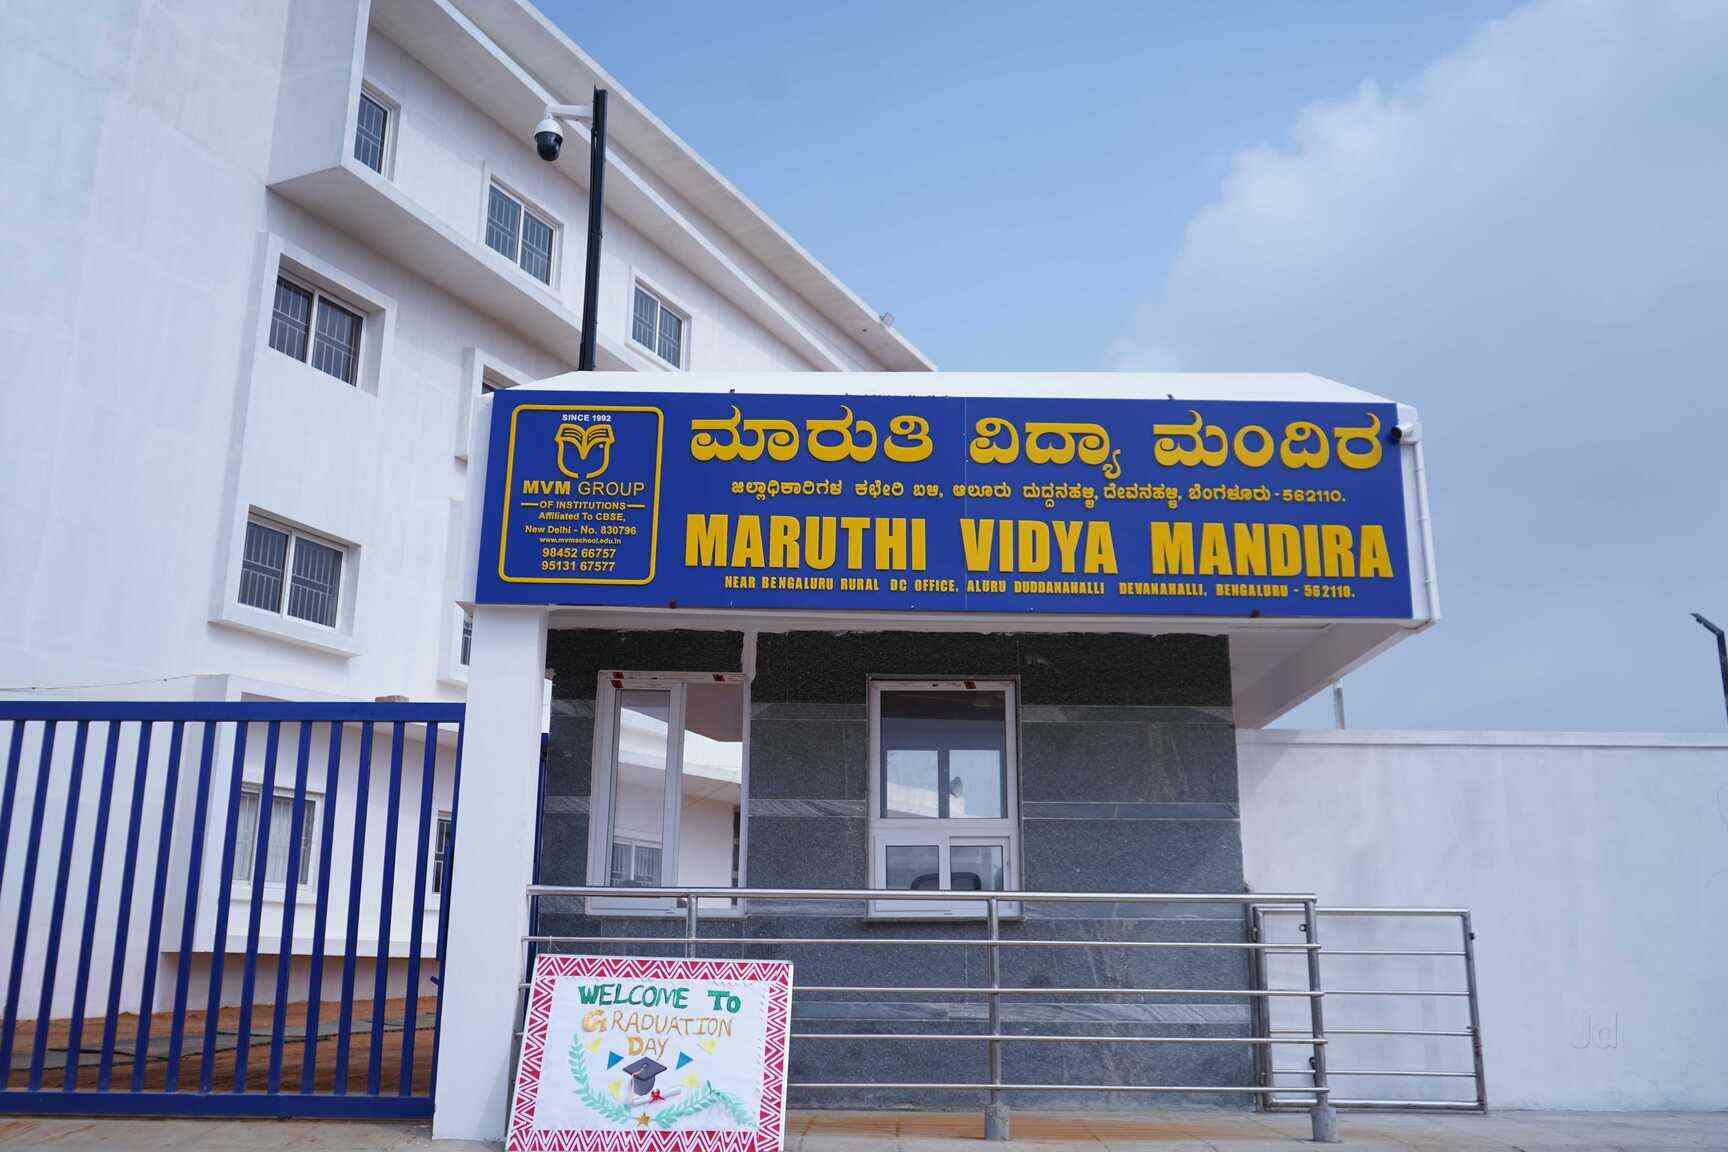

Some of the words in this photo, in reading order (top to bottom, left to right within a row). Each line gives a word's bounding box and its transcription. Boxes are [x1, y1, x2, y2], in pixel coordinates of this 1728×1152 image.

[691, 405, 933, 462] ಮಾರುತಿ
[970, 418, 1121, 479] ವಿದ್ಯಾ
[1153, 410, 1382, 469] ಮಂದಿರ
[523, 480, 570, 495] MVM
[578, 482, 644, 496] GROUP
[557, 501, 626, 510] INSTITUTIONS
[539, 512, 579, 520] Affiliated
[582, 512, 593, 520] To
[525, 525, 545, 533] New
[581, 526, 596, 534] No.
[601, 526, 636, 535] 830796
[543, 548, 577, 557] 98452
[581, 548, 616, 558] 66757
[685, 514, 926, 570] MARUTHI
[960, 519, 1118, 573] VIDYA
[1151, 522, 1393, 577] MANDIRA
[541, 561, 575, 570] 95131
[580, 561, 615, 571] 67577
[725, 576, 755, 588] NEAR
[762, 577, 833, 590] BENGALURU
[841, 578, 879, 590] RURAL
[967, 580, 1006, 592] ALURU
[1014, 581, 1104, 594] DUDDANAHALLI
[1216, 584, 1288, 597] BENGALURU
[578, 984, 689, 1009] WELCOME
[583, 1009, 732, 1036] GRADUATION
[628, 1036, 668, 1060] DAY
